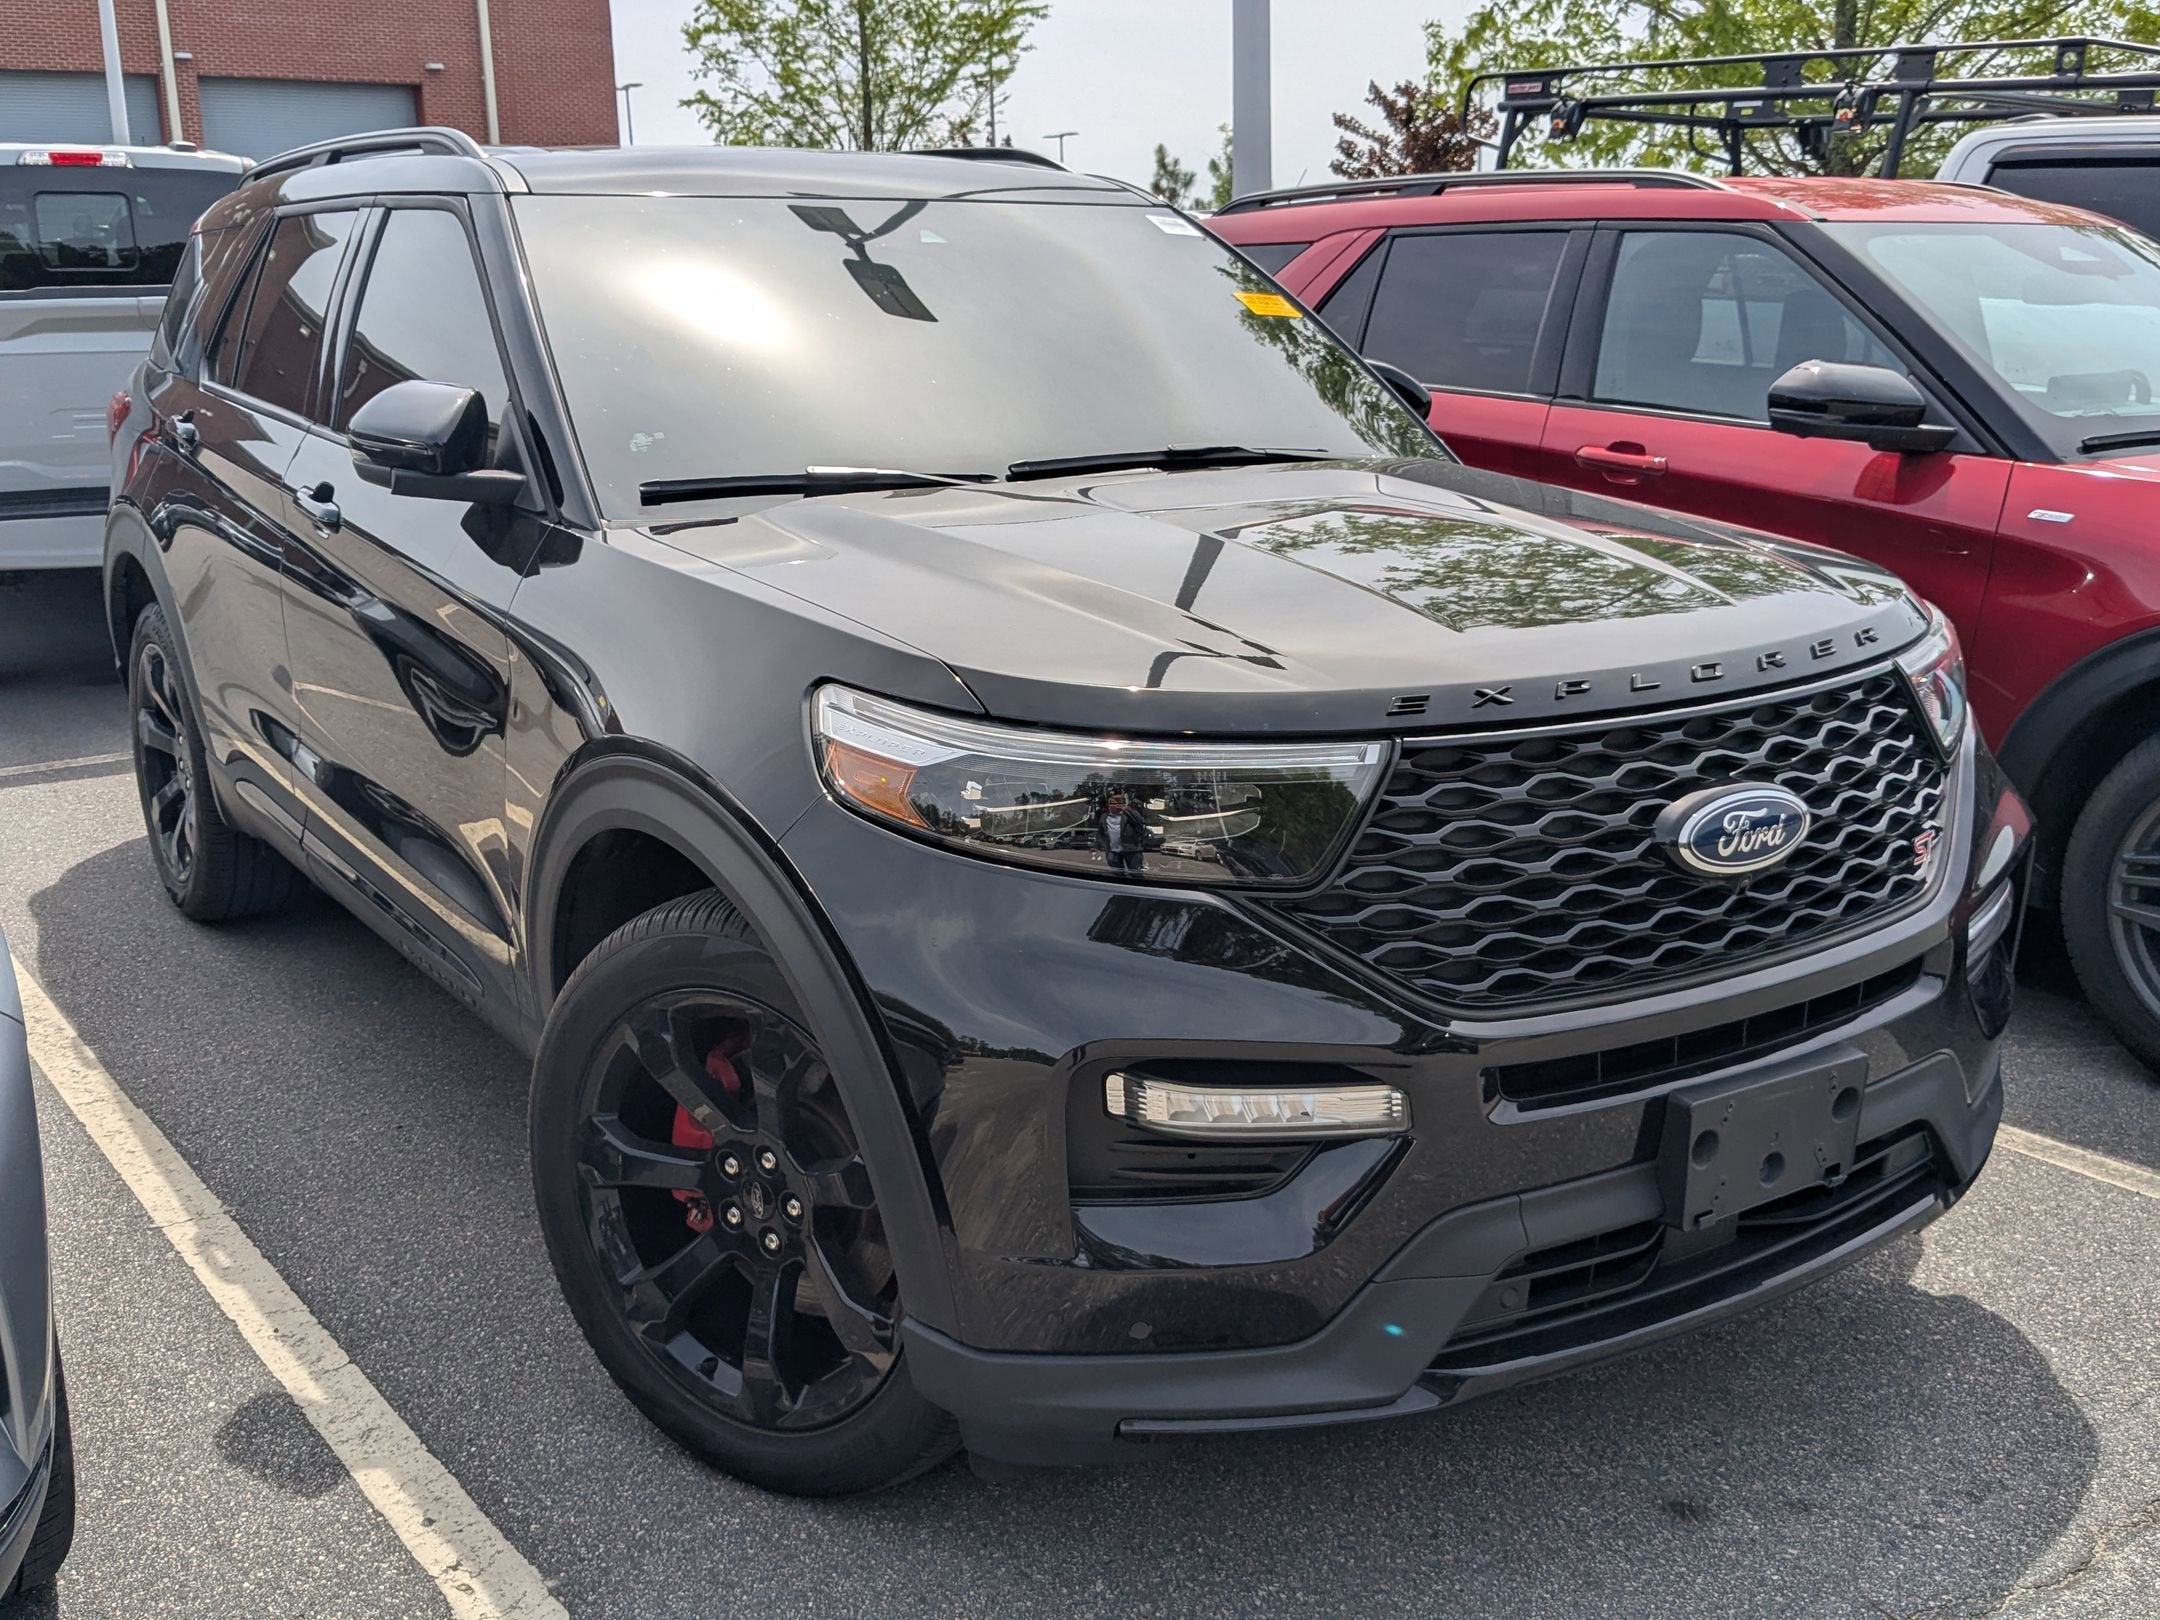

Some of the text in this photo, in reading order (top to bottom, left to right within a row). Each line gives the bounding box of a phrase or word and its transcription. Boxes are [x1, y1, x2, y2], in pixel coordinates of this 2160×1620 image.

[1385, 626, 1880, 716] EXPLORER
[1718, 808, 1787, 857] Ford
[1912, 829, 1936, 866] ST
